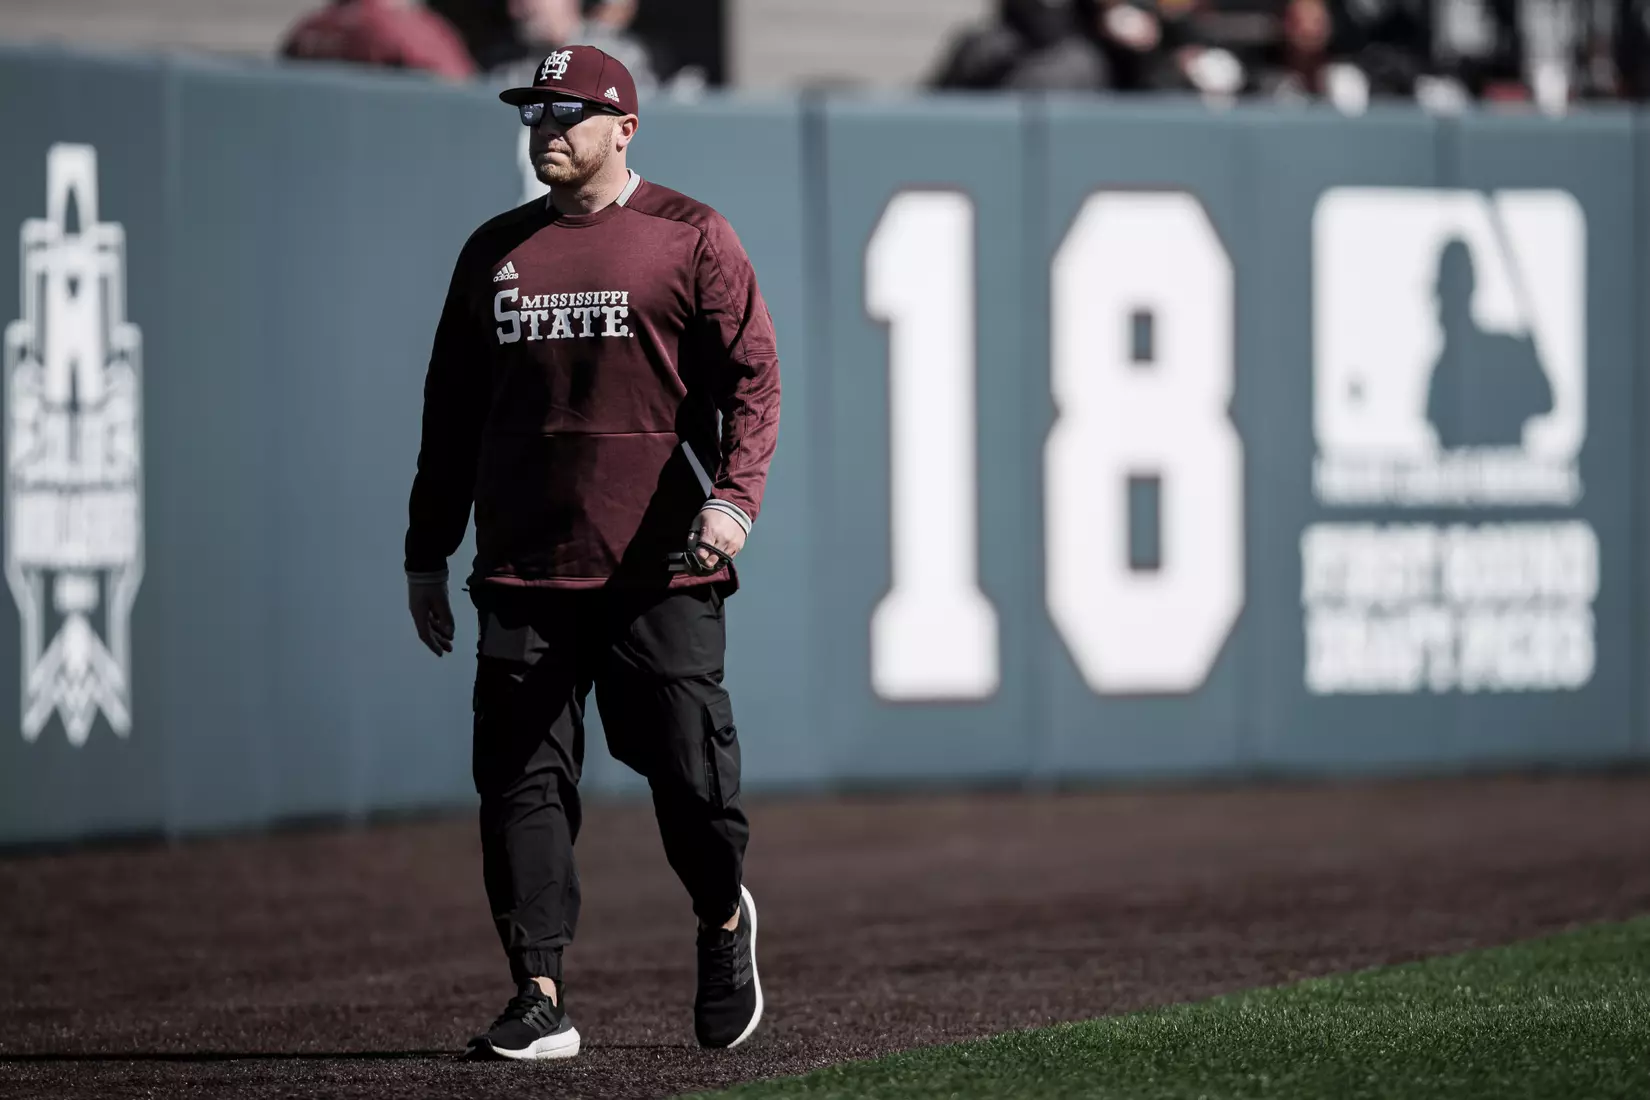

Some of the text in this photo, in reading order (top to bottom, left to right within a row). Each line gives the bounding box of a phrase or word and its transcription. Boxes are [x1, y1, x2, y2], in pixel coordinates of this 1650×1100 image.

[493, 272, 519, 283] adidas
[521, 291, 629, 309] MISSISSIPPI
[865, 190, 1246, 700] 18
